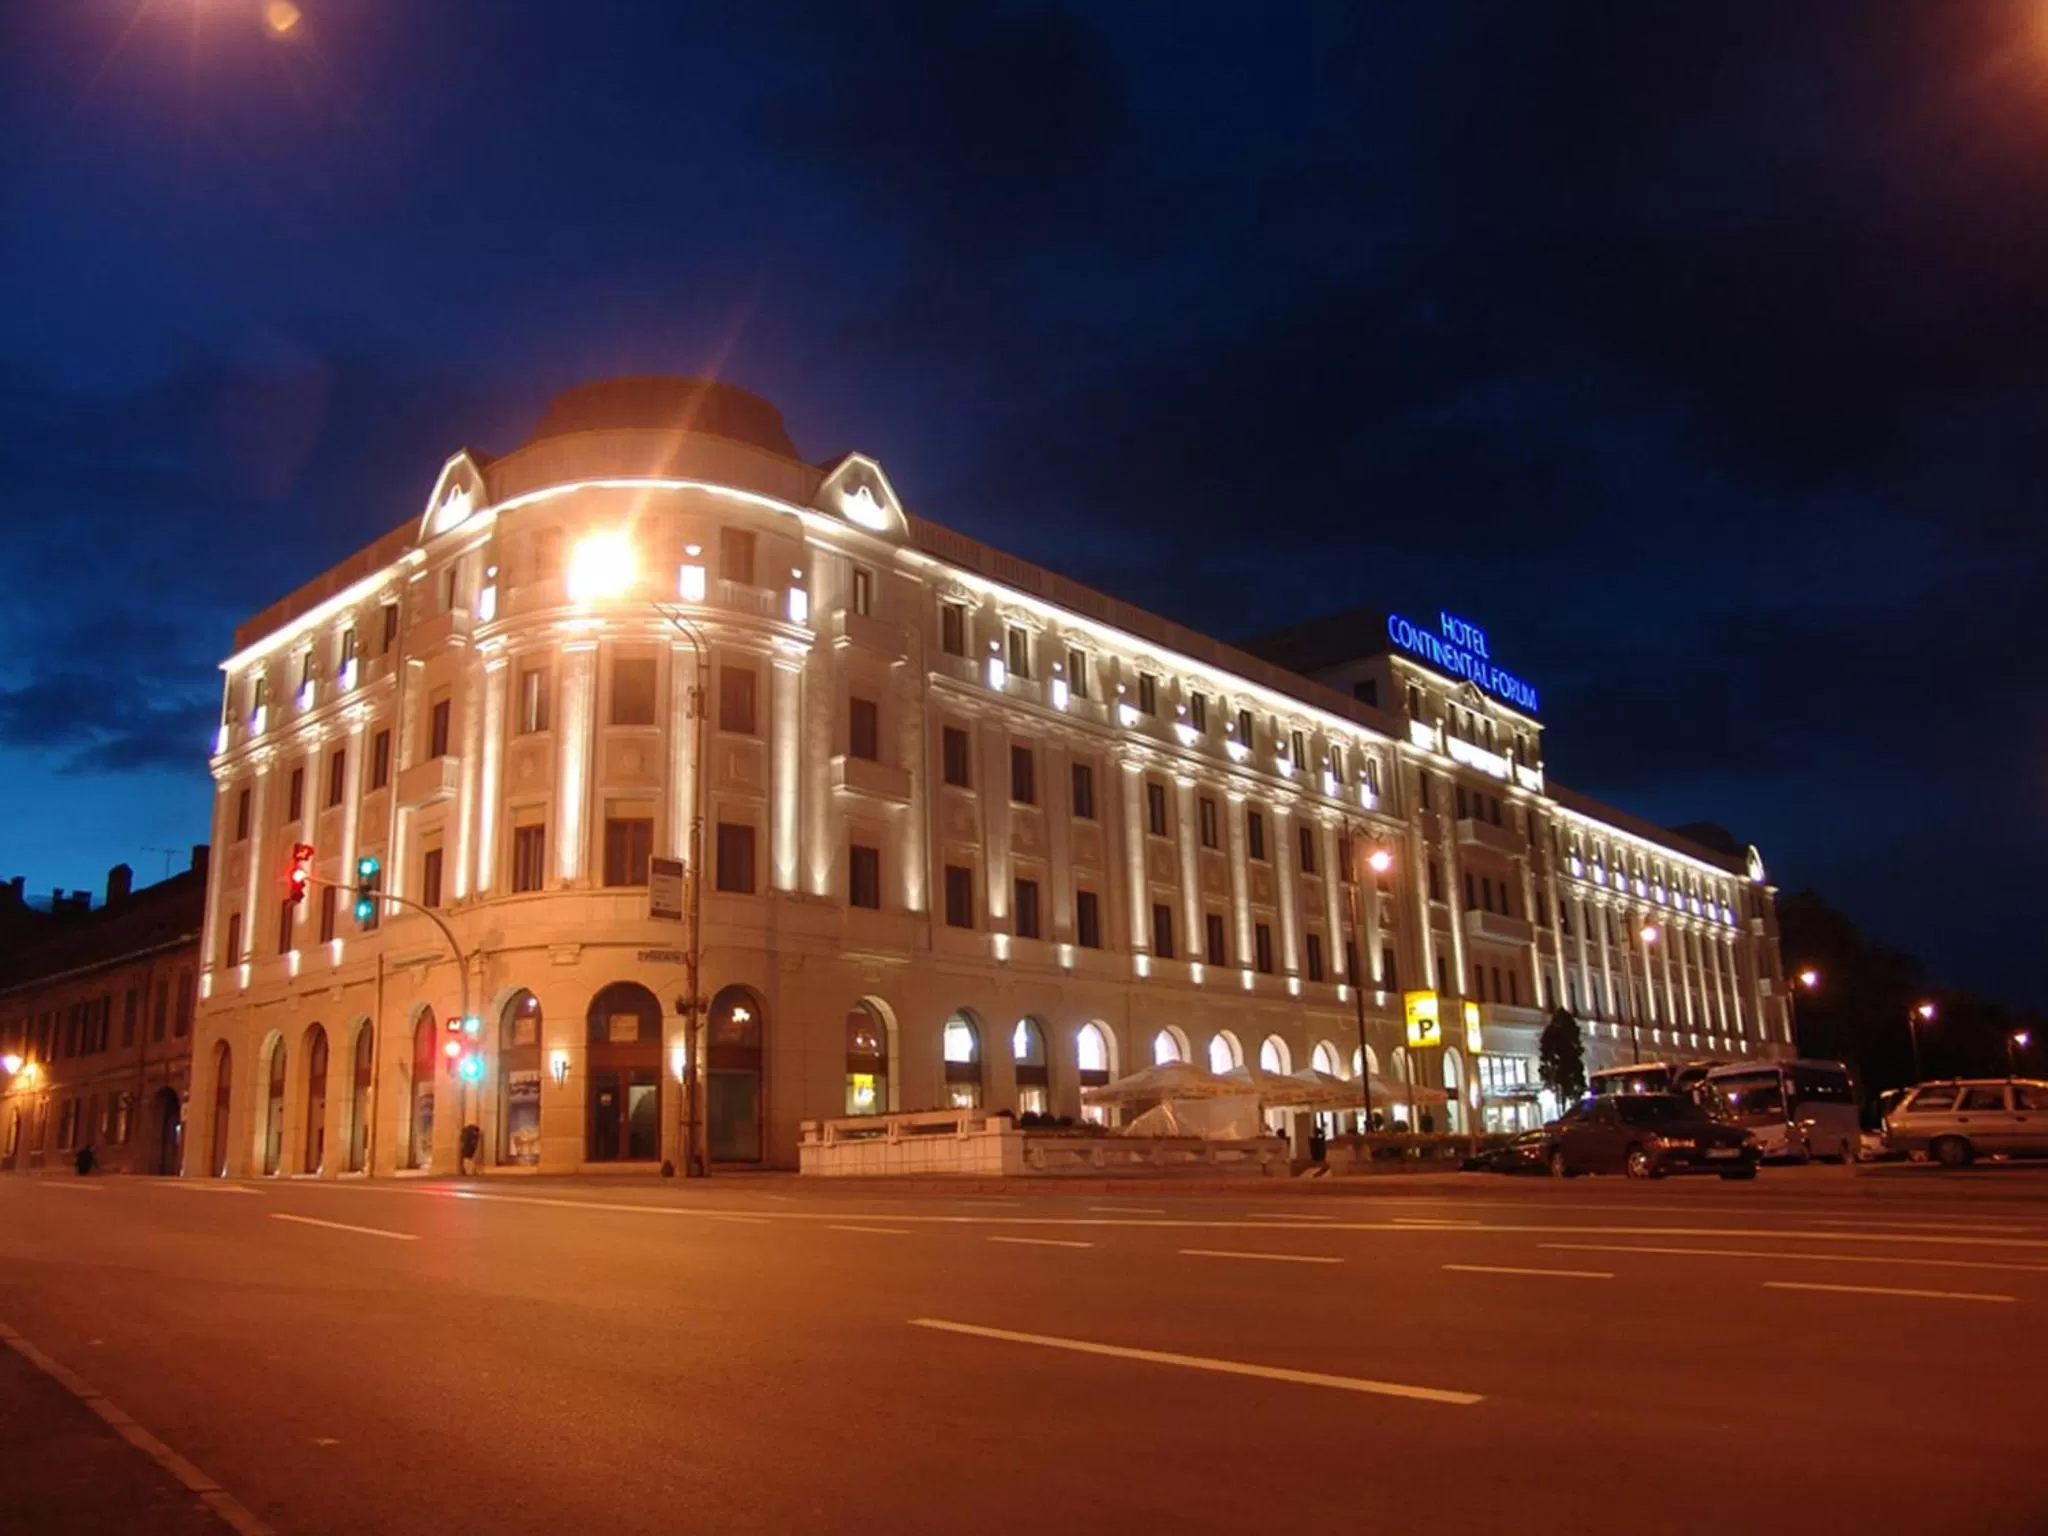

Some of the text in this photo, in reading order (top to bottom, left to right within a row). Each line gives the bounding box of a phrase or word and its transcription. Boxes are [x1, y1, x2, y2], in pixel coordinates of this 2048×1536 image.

[1440, 611, 1489, 659] HOTEL
[1387, 615, 1538, 711] CONTINENTAL FORUM
[1418, 1019, 1434, 1039] P
